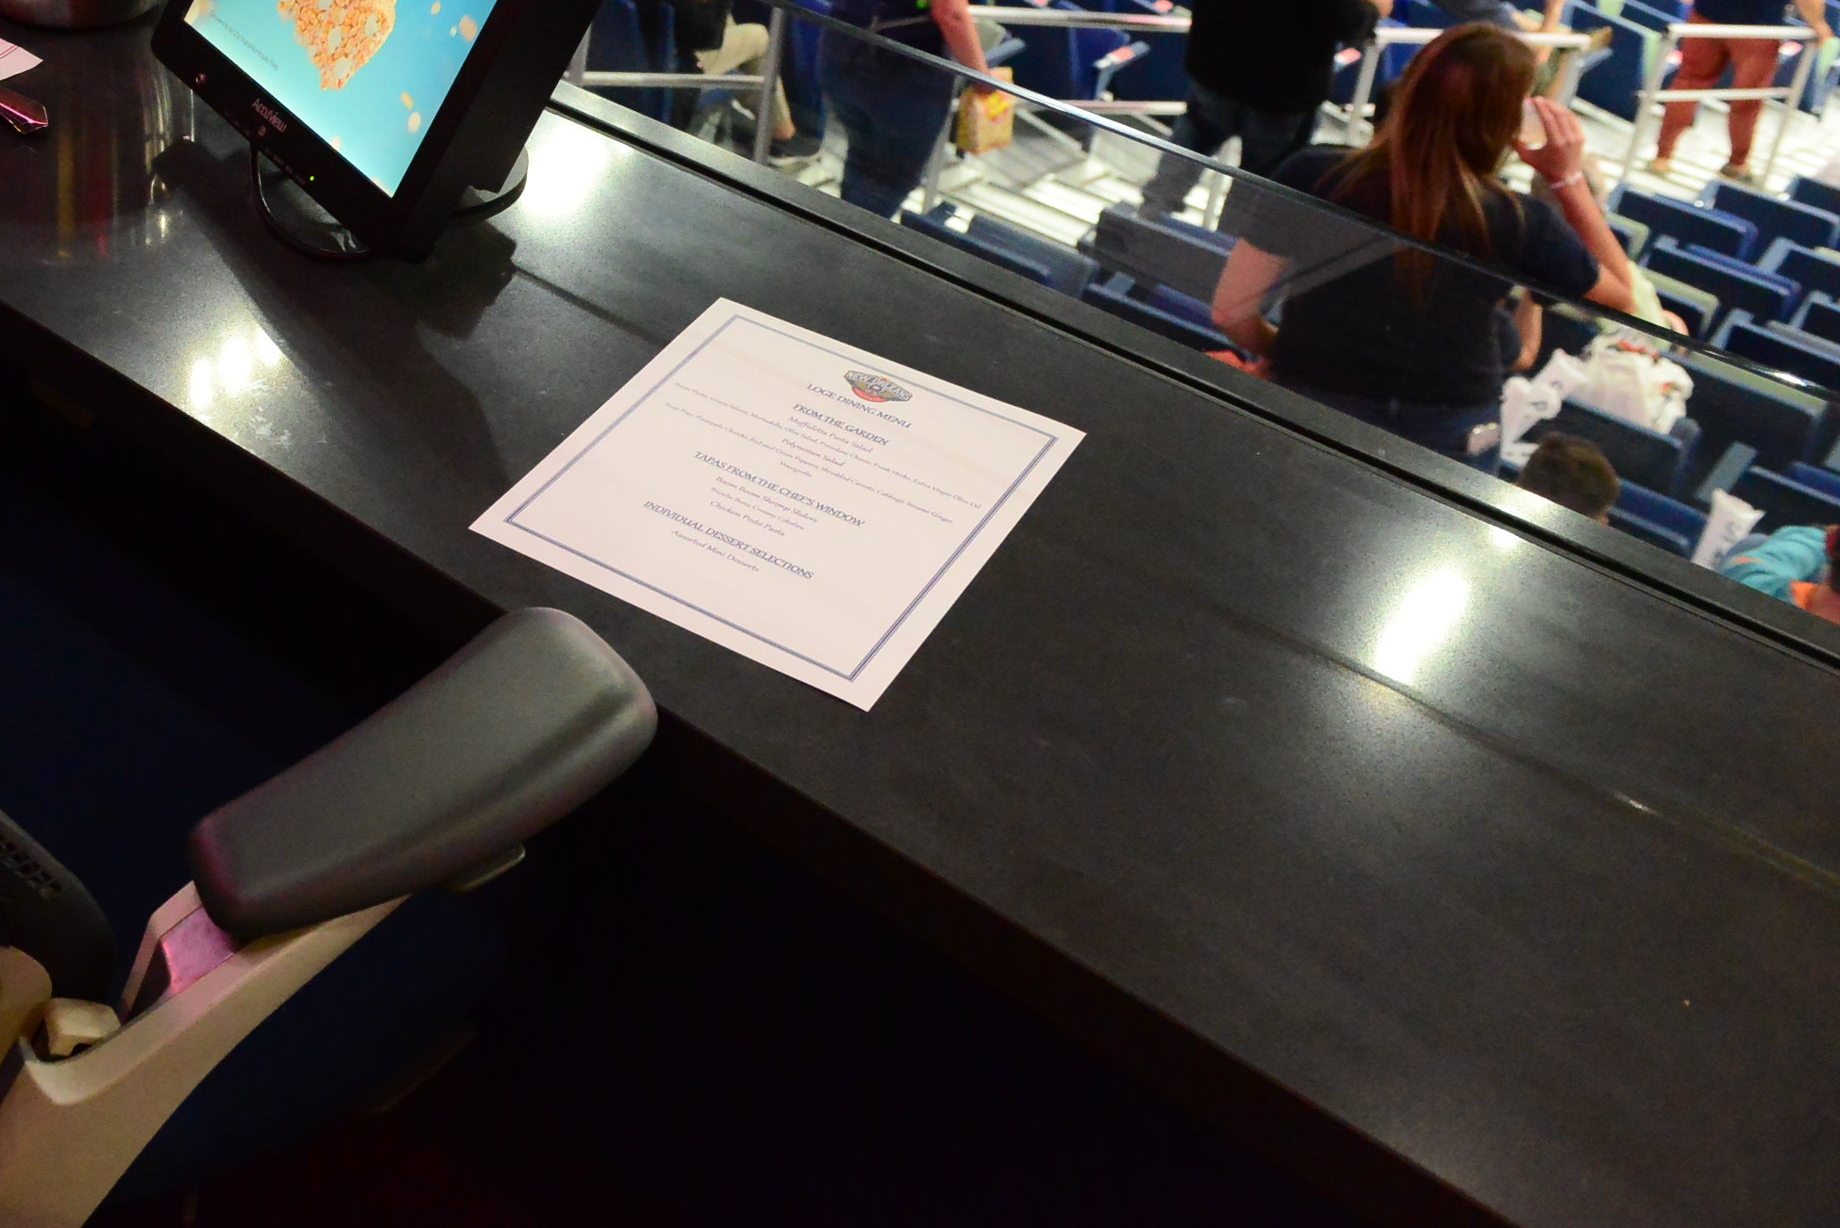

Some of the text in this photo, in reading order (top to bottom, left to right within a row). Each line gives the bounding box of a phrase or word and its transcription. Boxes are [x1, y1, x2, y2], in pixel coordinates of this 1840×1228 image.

[791, 403, 889, 445] FROM THE GARDEN
[806, 383, 912, 428] LOGE DINING MENU
[692, 451, 727, 469] TAPAS
[724, 465, 758, 482] FROM
[755, 477, 780, 491] THE
[813, 502, 865, 527] WINDOW
[642, 500, 815, 579] INDIVIDUAL DESSERT SELECTIONS
